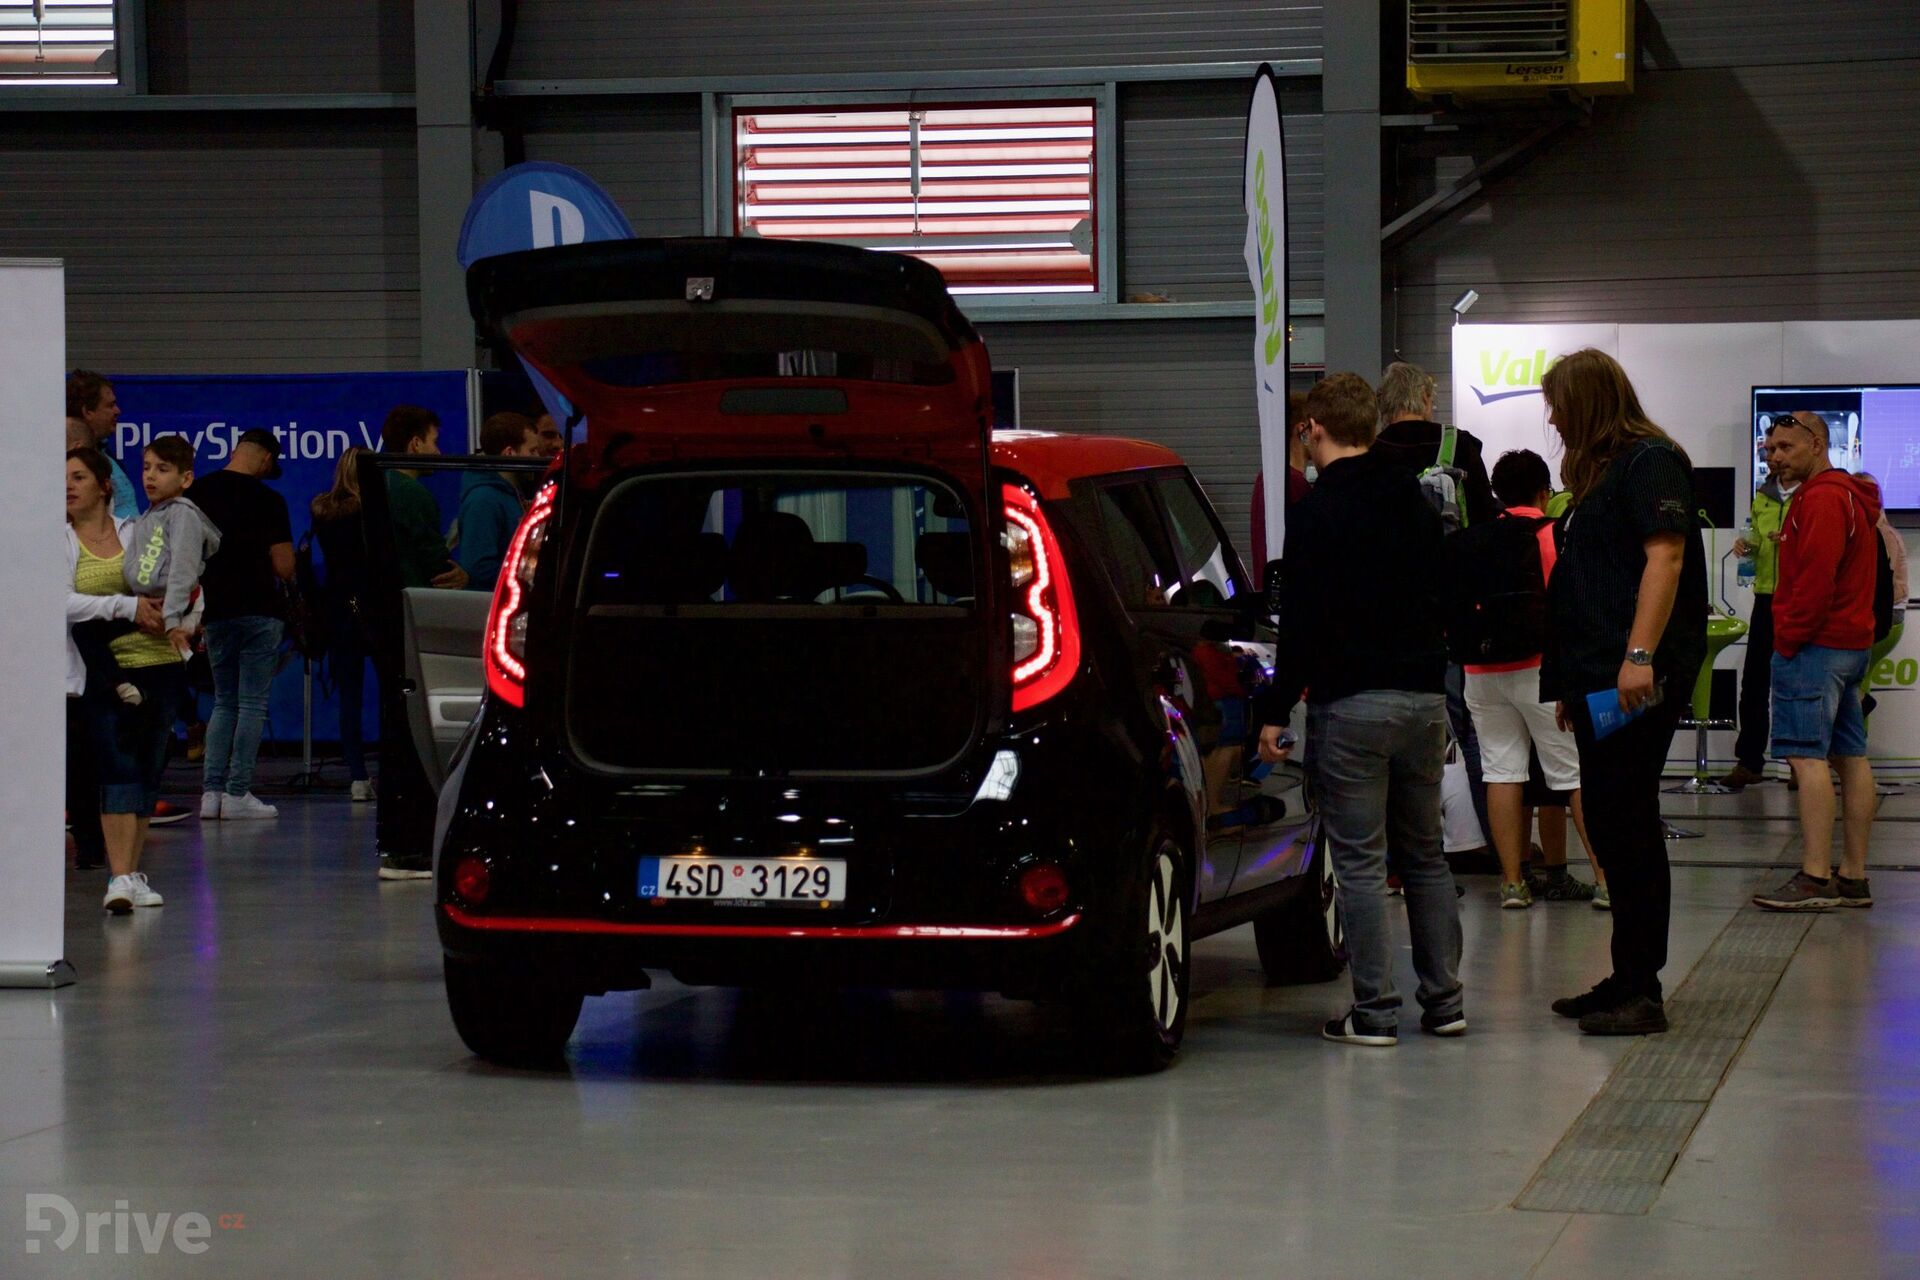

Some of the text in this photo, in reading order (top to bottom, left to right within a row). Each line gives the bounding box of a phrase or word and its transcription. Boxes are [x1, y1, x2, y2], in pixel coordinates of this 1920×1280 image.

[1505, 64, 1564, 75] Lersen
[1479, 349, 1564, 386] Val
[116, 421, 350, 460] PlySttion
[137, 526, 164, 585] adidas
[641, 886, 656, 896] CZ
[666, 864, 831, 898] 4SD 3129
